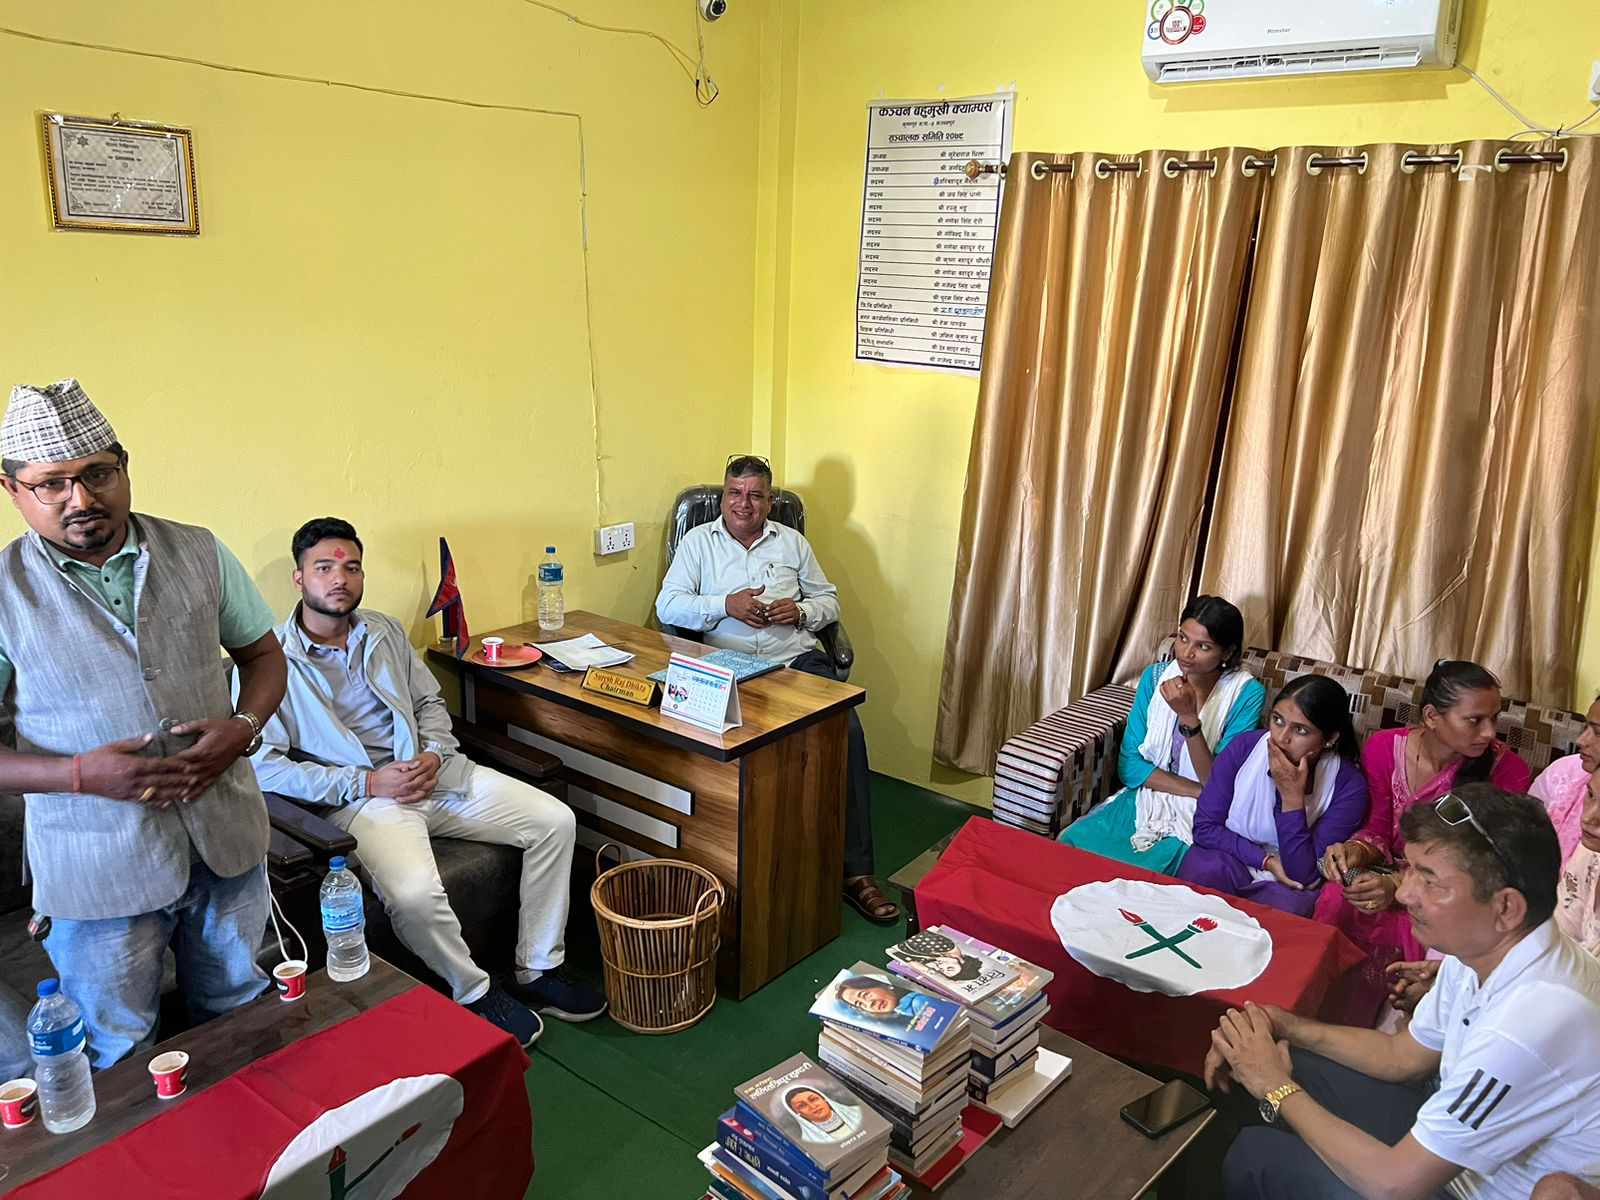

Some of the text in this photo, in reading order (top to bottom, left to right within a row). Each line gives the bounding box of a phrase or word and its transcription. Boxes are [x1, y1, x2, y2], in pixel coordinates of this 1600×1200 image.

[879, 101, 992, 118] कञ्चन बहुमुखी क्याम्पस
[922, 131, 943, 142] समिति
[600, 682, 634, 698] Chairman
